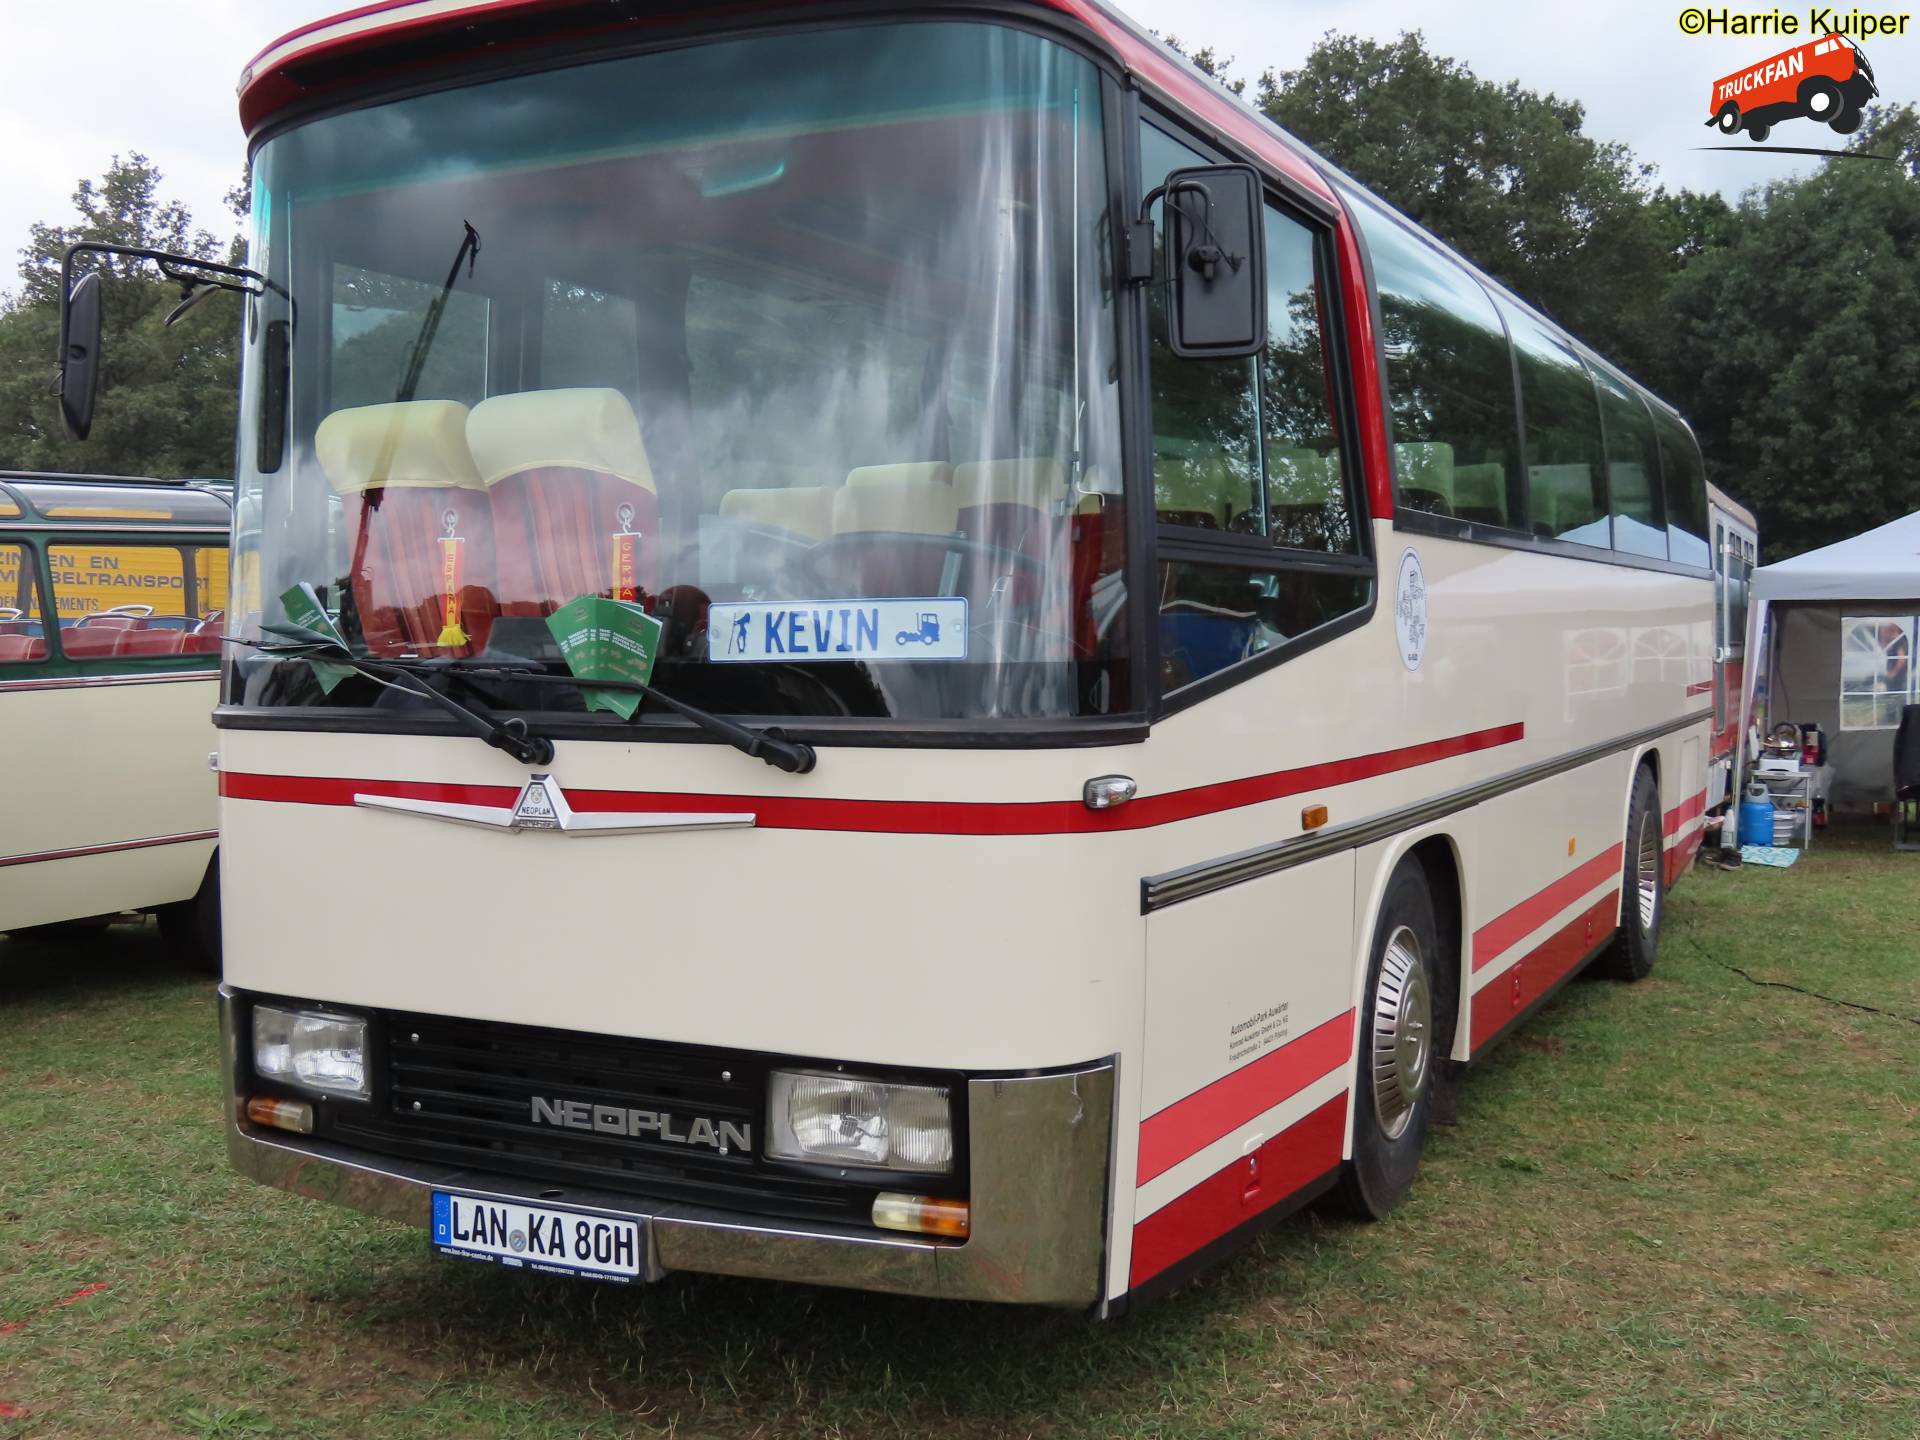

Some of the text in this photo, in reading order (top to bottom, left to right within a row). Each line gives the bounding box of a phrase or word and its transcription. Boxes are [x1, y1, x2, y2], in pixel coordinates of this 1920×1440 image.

[91, 556, 118, 569] EN
[765, 608, 879, 653] KEVIN
[521, 806, 551, 816] NEOPLAN
[530, 1096, 751, 1152] NEOPLAN
[439, 1224, 446, 1235] D
[453, 1201, 634, 1267] LAN KA 80H
